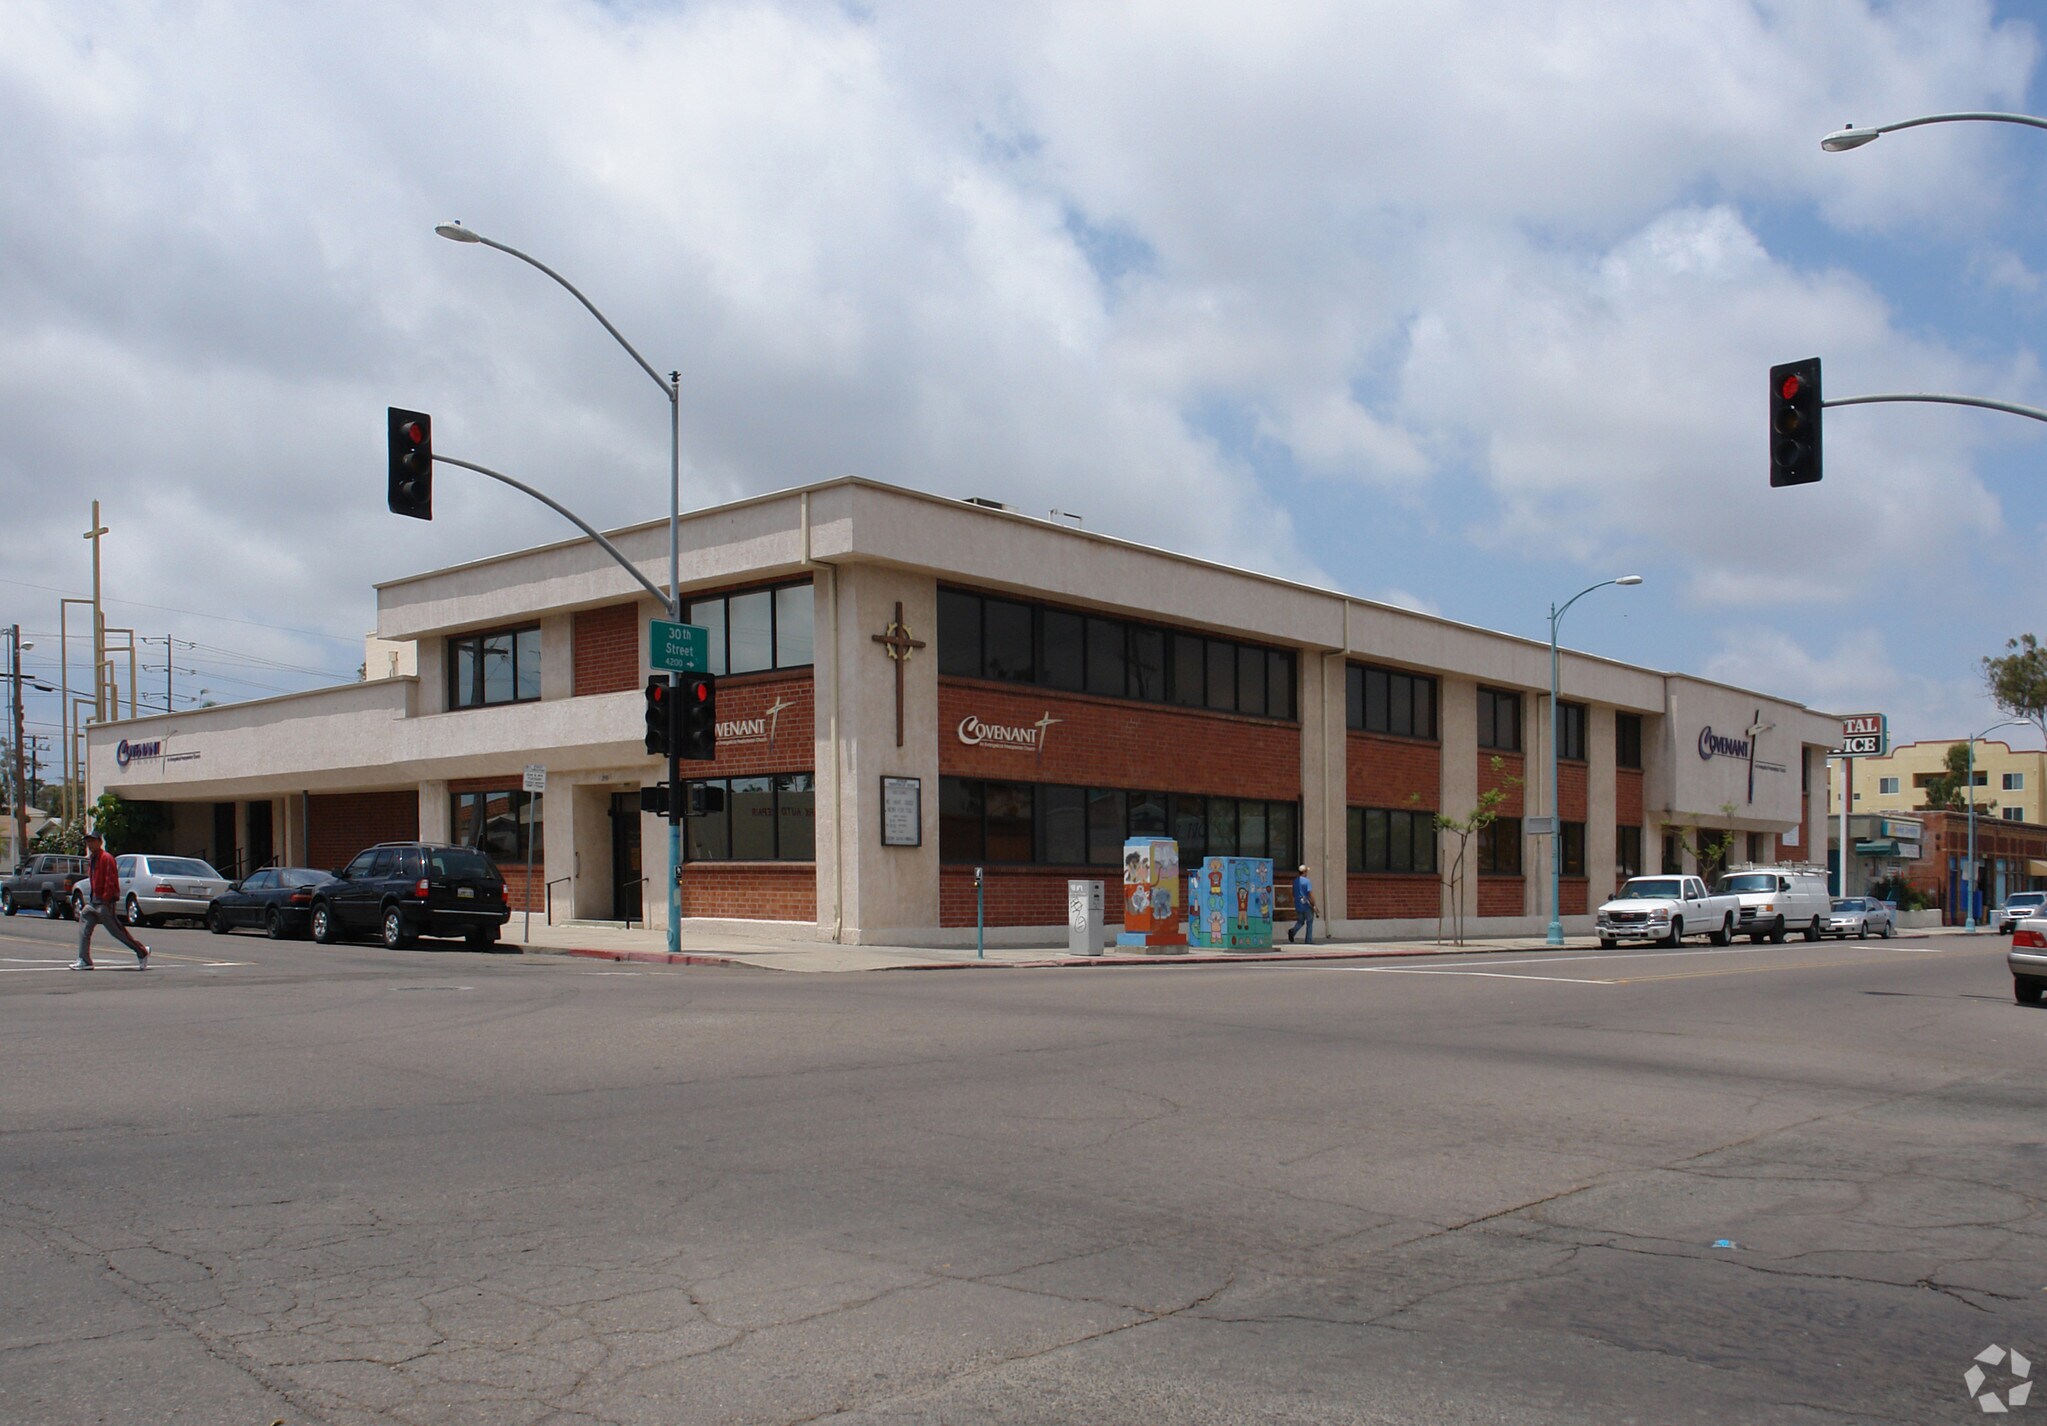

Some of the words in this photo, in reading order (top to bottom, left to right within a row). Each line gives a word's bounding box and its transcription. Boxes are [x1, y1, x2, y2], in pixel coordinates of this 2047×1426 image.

[669, 627, 692, 640] 30th
[665, 642, 694, 657] Street
[665, 657, 684, 667] 4200
[715, 718, 766, 737] VENANT
[958, 715, 1038, 745] COVENANT
[1844, 718, 1878, 733] TAL
[1697, 725, 1750, 760] COVENANT
[1843, 737, 1876, 752] ICE
